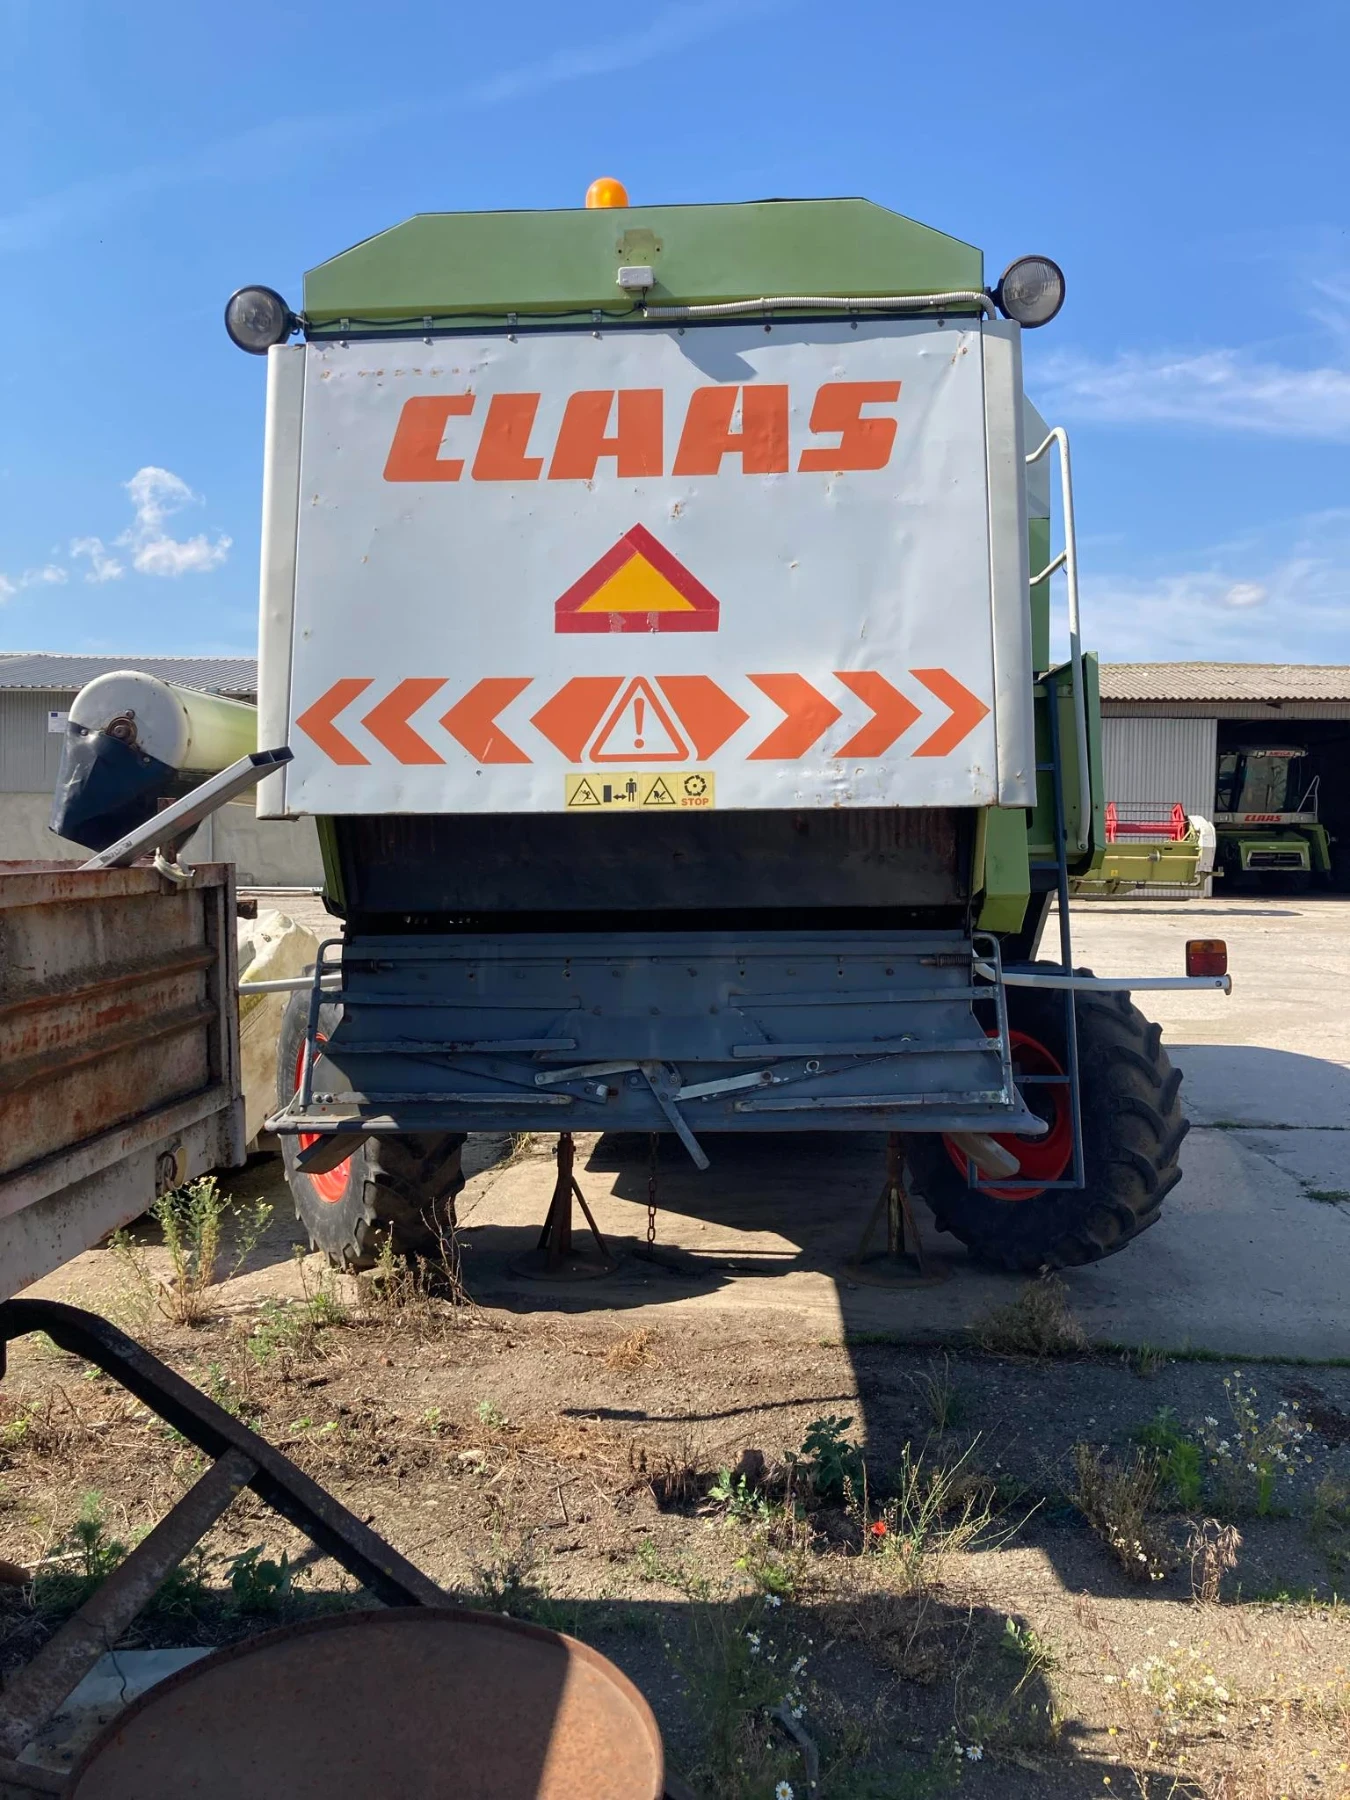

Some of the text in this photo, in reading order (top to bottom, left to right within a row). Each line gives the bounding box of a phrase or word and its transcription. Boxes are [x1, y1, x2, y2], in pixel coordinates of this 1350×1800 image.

[383, 381, 902, 482] CLAAS
[681, 797, 709, 806] STOP
[1244, 814, 1282, 822] CLAAS
